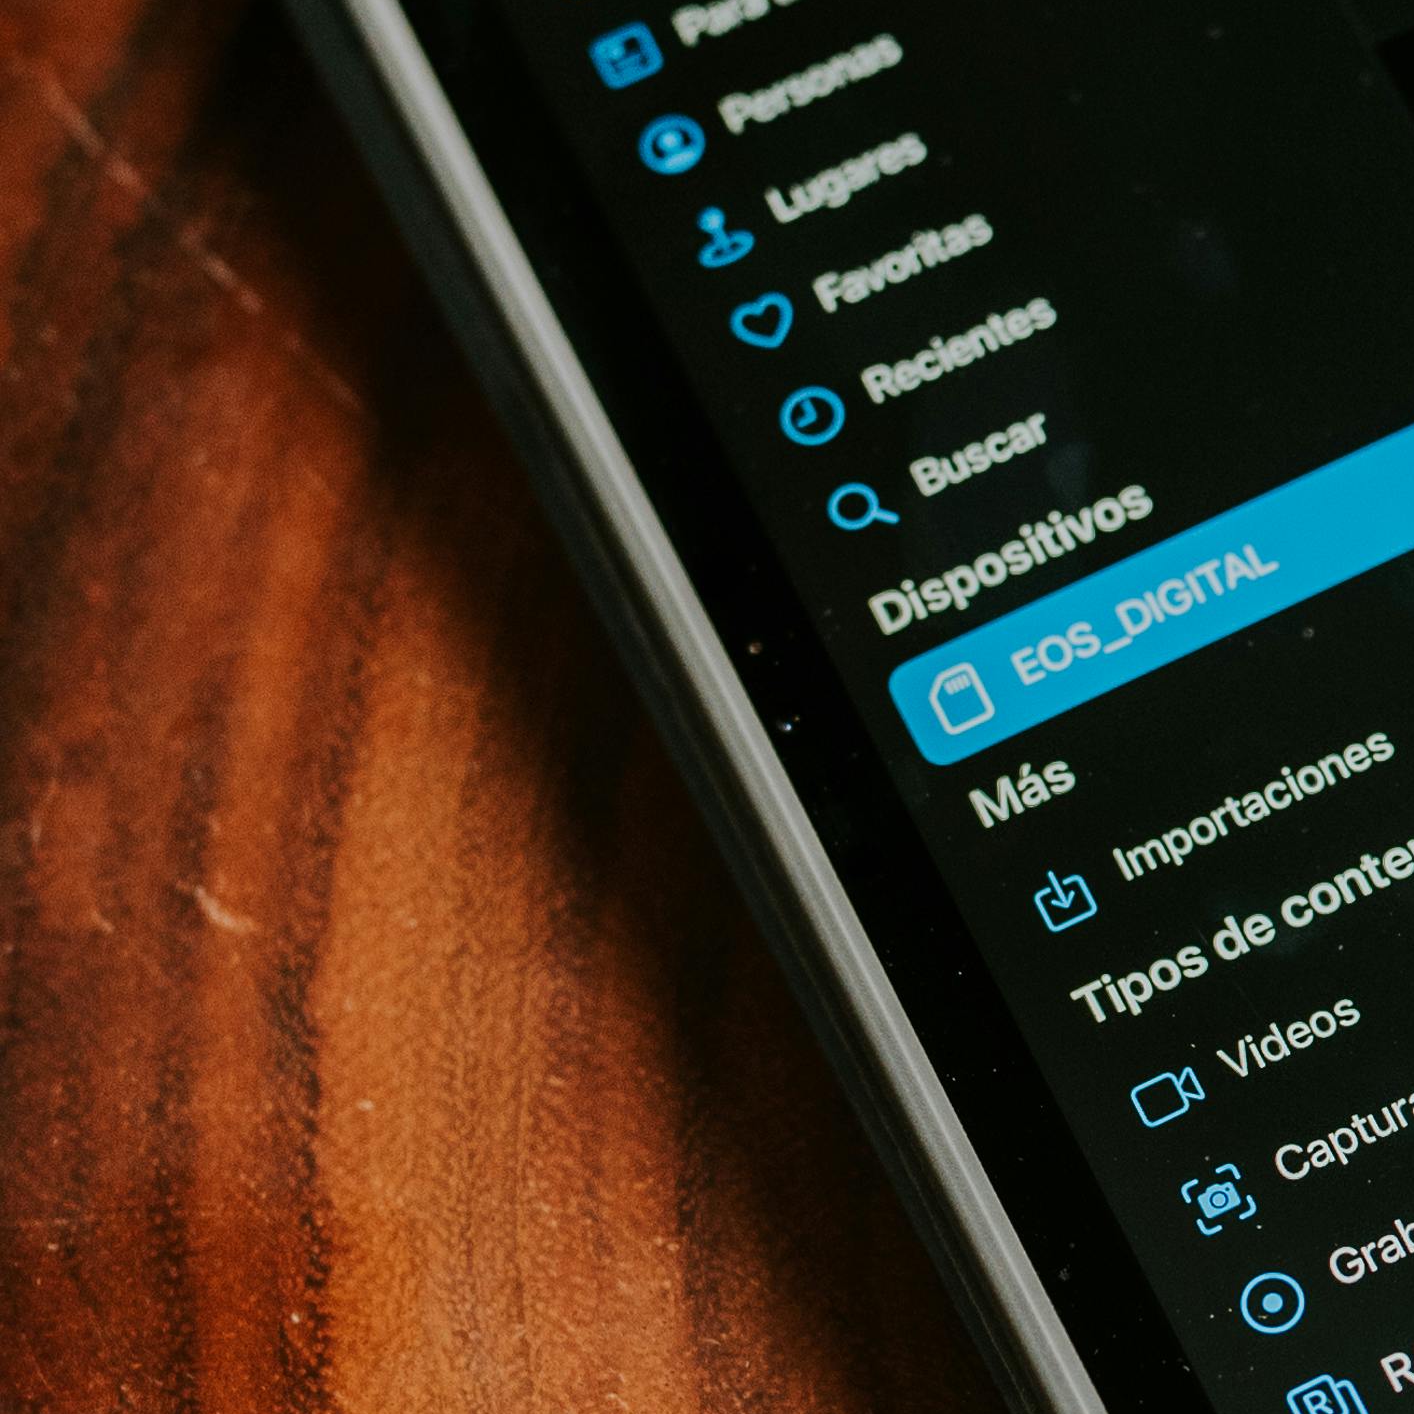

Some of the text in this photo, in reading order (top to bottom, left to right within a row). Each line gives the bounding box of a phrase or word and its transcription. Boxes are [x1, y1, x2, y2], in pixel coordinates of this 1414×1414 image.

[764, 133, 927, 224] Lugares
[812, 214, 994, 313] Favoritas
[861, 297, 1057, 404] Recientes
[909, 412, 1047, 497] Buscar
[868, 484, 1154, 636] Dispositivos
[1011, 545, 1279, 685] EOS_DIGITAL
[968, 758, 1076, 829] Más
[1112, 732, 1395, 882] Importaciones
[1069, 945, 1209, 1023] Tipos
[1212, 913, 1276, 961] de
[1215, 996, 1361, 1078] Videos
